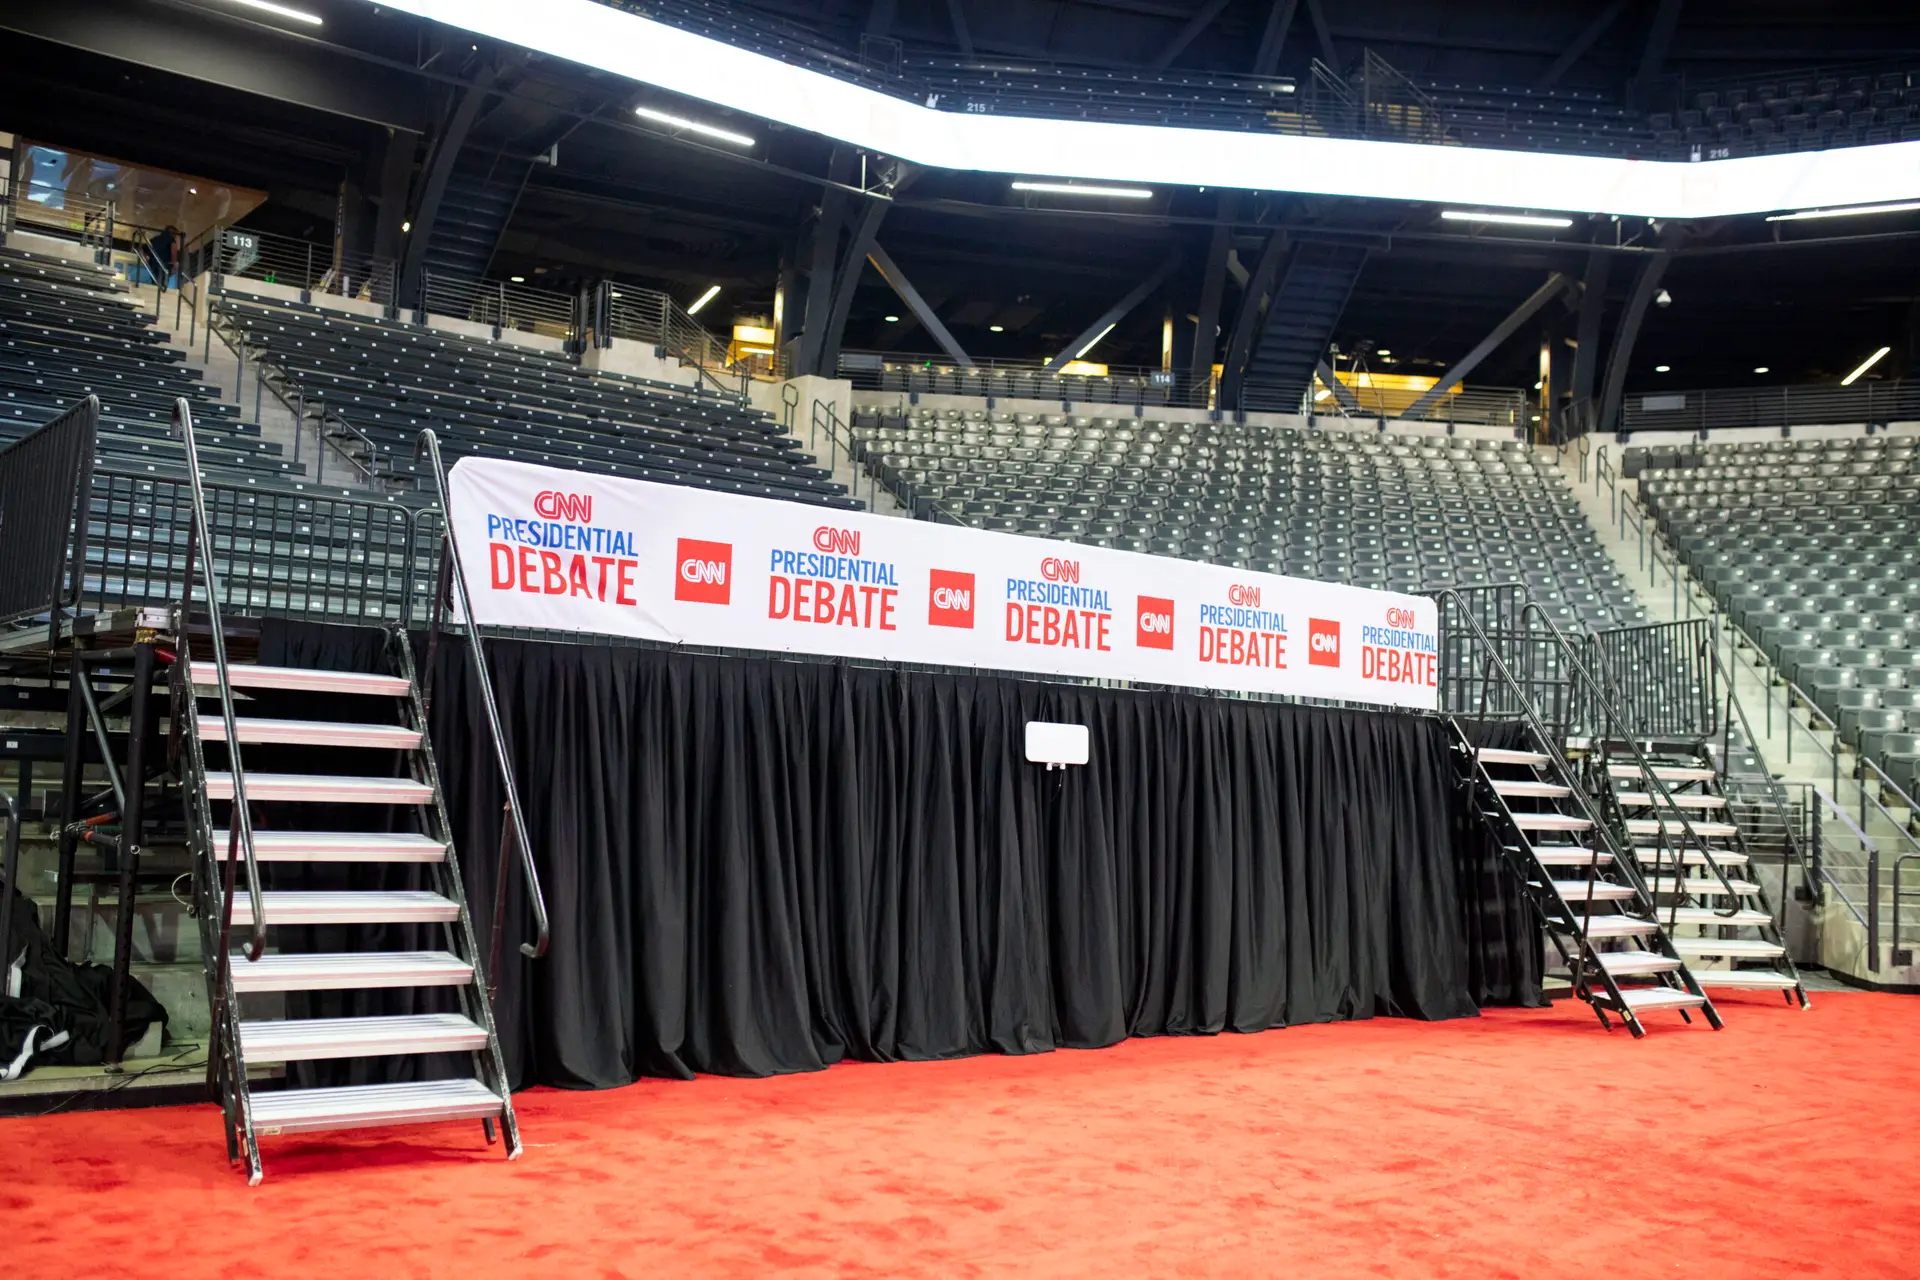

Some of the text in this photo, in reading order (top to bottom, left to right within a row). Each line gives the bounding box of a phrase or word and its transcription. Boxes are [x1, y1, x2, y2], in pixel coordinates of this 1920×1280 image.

[966, 102, 985, 112] 215
[232, 235, 252, 248] 113
[534, 491, 592, 523] CNN
[488, 514, 638, 557] PRESIDENTIAL
[813, 526, 860, 556] CNN
[489, 543, 638, 606] DEBATE
[681, 558, 726, 585] CNN
[771, 549, 899, 586] PRESIDENTIAL
[1041, 557, 1079, 583] CNN
[769, 576, 898, 630] DEBATE
[933, 587, 970, 611] CNN
[1006, 579, 1112, 611] PRESIDENTIAL
[1229, 584, 1260, 607] CNN
[1006, 605, 1111, 651] DEBATE
[1140, 612, 1170, 634] CNN
[1200, 604, 1288, 632] PRESIDENTIAL
[1386, 607, 1414, 629] CNN
[1200, 626, 1287, 669] DEBATE
[1311, 633, 1337, 653] CNN
[1362, 625, 1437, 652] PRESIDENTIAL
[1362, 645, 1437, 687] DEBATE
